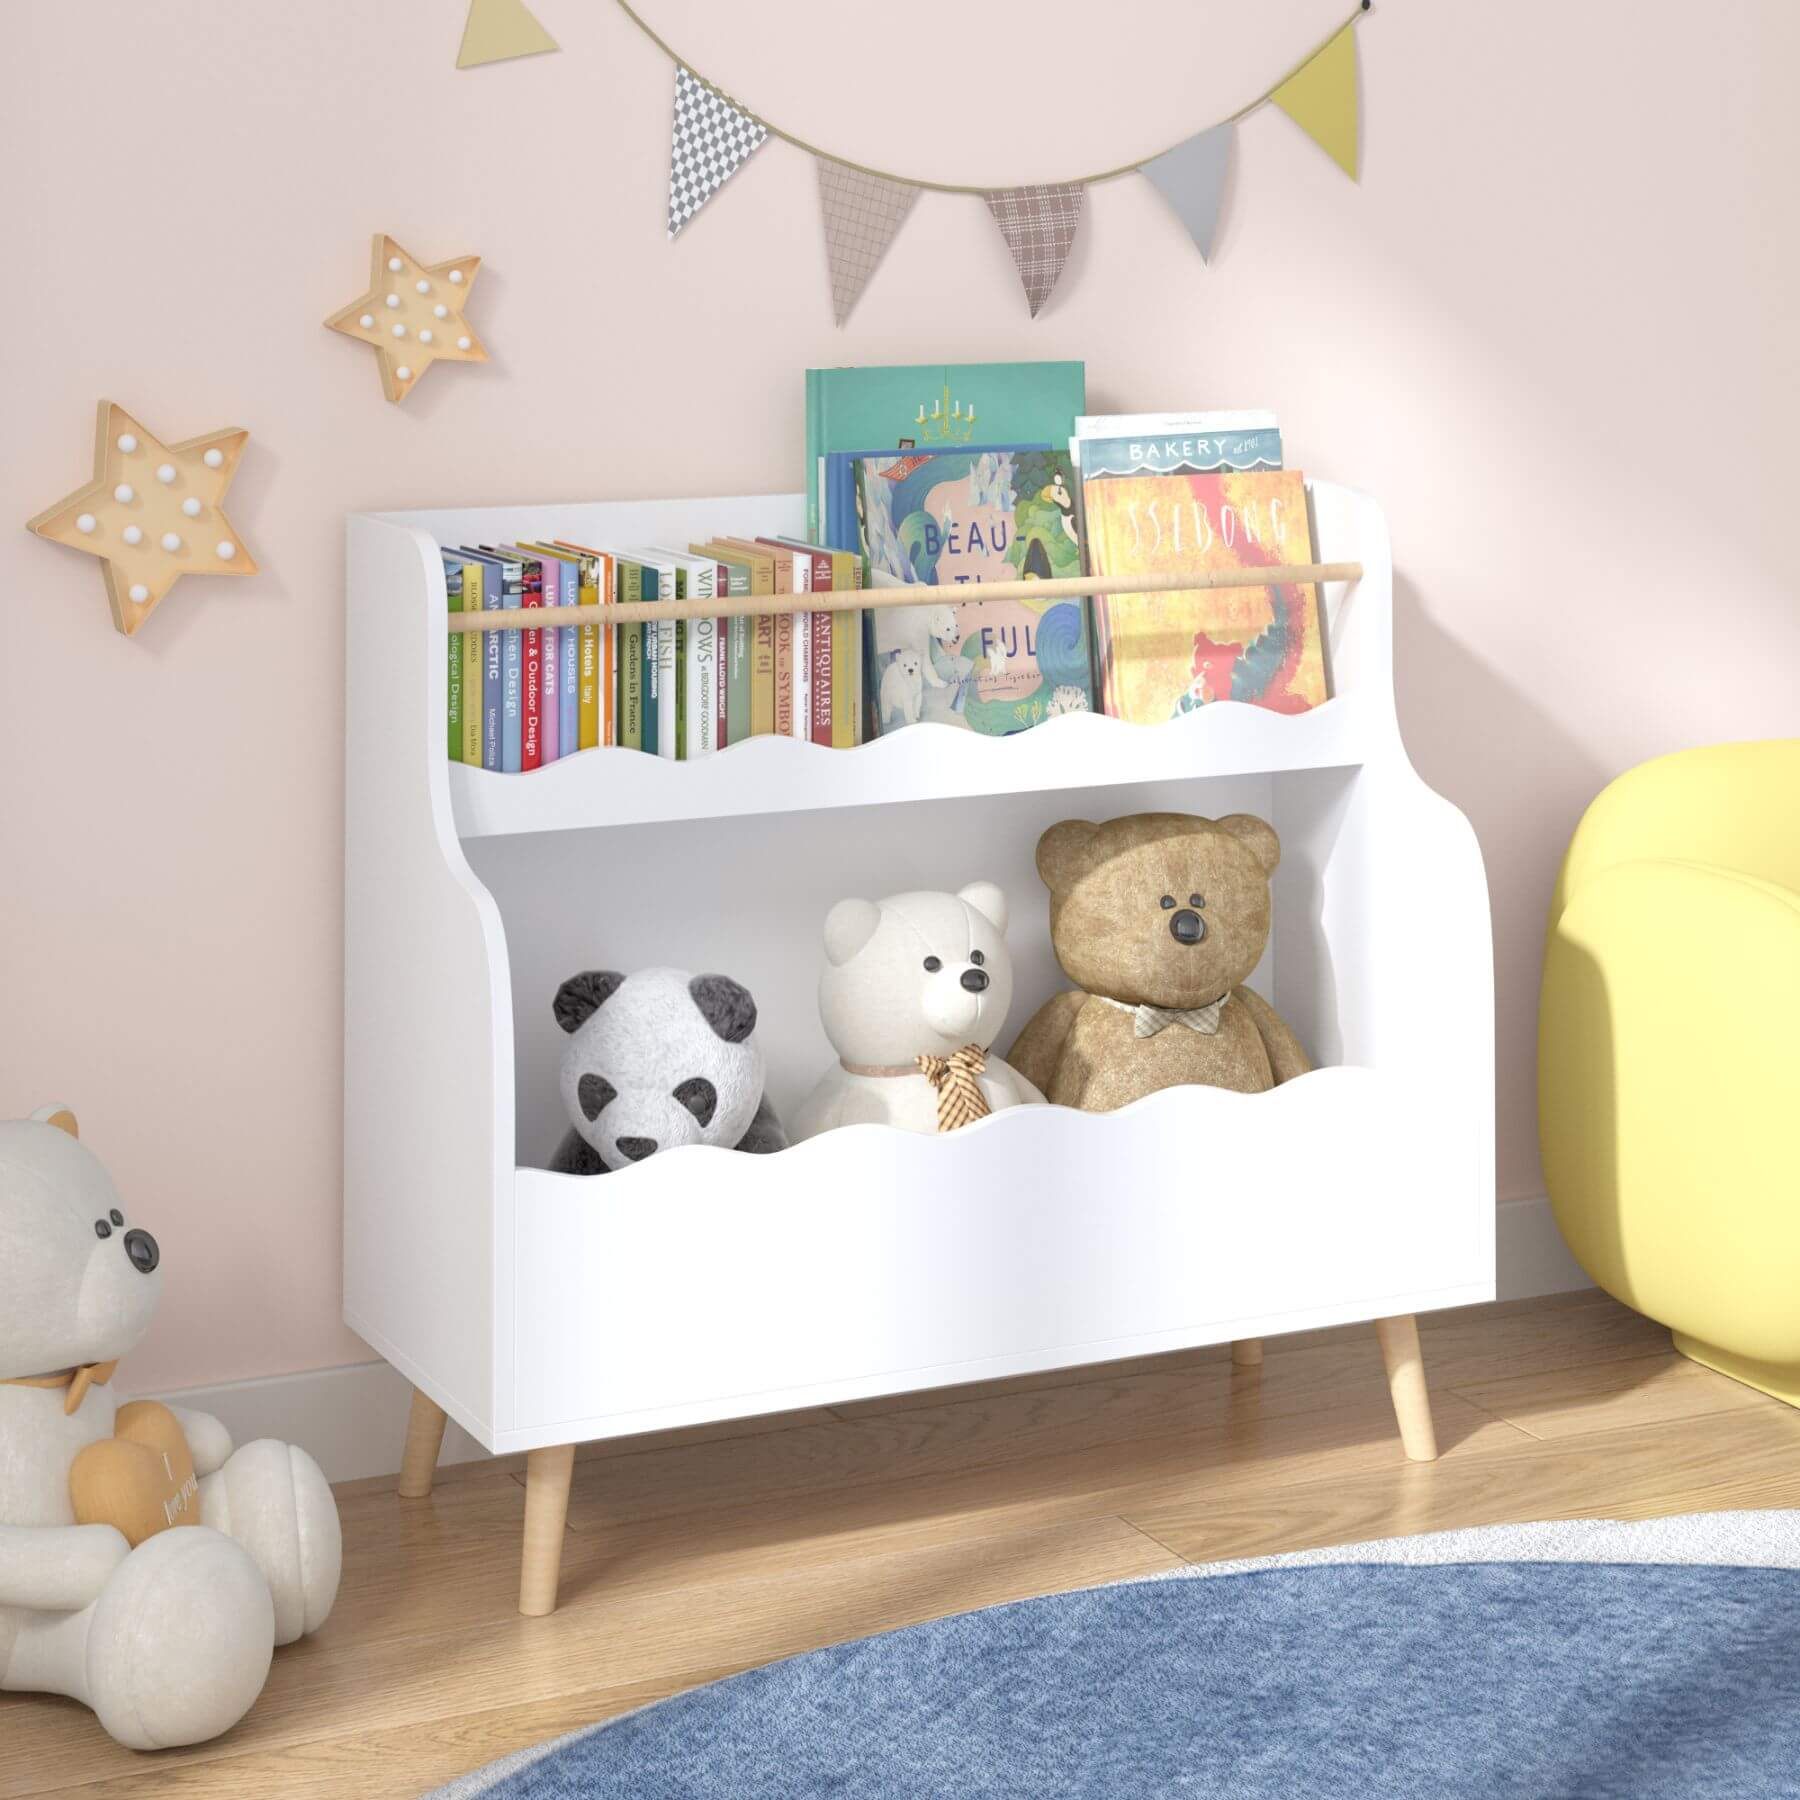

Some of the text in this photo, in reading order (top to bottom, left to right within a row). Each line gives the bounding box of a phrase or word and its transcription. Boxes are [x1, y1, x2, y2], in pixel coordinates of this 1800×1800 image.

[1129, 439, 1226, 460] BAKERY
[924, 520, 1027, 556] BEAU-
[567, 580, 576, 634] LUXY
[696, 569, 713, 663] WINOWS
[488, 594, 499, 680] ANRCTIC
[528, 648, 538, 657] &
[545, 585, 555, 695] LUXY FOR CATS
[584, 639, 594, 677] Hotels
[659, 627, 673, 670] FISH
[981, 625, 1037, 659] FUL
[449, 635, 460, 723] ological Design
[528, 661, 538, 712] Outdoor
[567, 638, 576, 694] HOUSES
[628, 634, 639, 734] Gardens in France
[718, 637, 726, 718] FRANK LLOYD WRIGHT
[820, 614, 832, 726] ANTIQUAIRES
[506, 668, 520, 717] Design
[582, 685, 593, 704] Italy
[778, 672, 790, 736] SYMBO
[526, 716, 538, 756] Design
[163, 1452, 173, 1480] I
[180, 1472, 199, 1511] you
